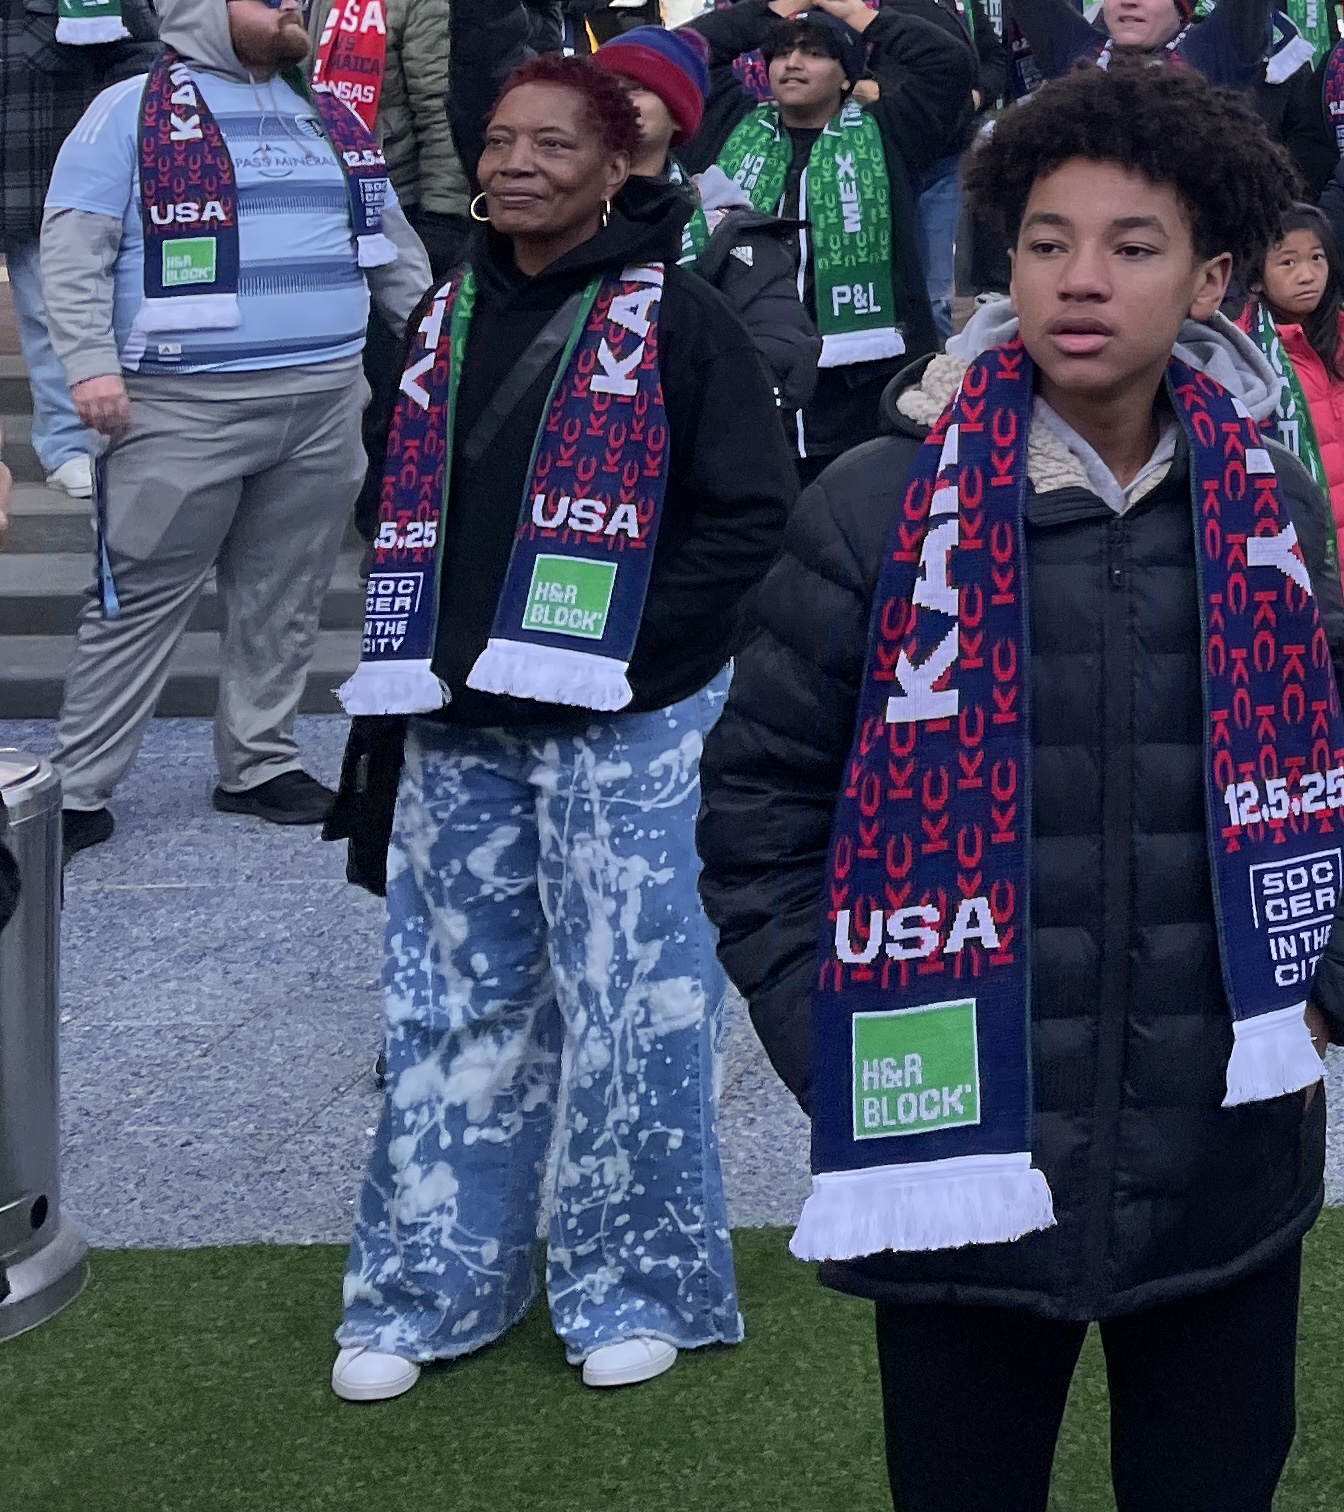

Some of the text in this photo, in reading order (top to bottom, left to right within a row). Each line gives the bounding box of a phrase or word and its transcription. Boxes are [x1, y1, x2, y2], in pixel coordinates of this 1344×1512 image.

[275, 155, 337, 169] MINERAL
[151, 200, 226, 225] USA
[835, 152, 861, 233] MEX
[165, 267, 212, 282] BLOCK
[166, 254, 192, 269] H&R
[832, 282, 881, 316] P&L
[587, 390, 611, 436] KC
[960, 364, 989, 433] KC
[558, 418, 580, 467] KC
[604, 424, 626, 472] KC
[645, 425, 666, 476] KC
[991, 407, 1017, 486] KC
[531, 493, 639, 538] USA
[894, 477, 934, 562] KC
[960, 466, 984, 550] KC
[991, 522, 1014, 604] KC
[536, 580, 578, 604] H&R
[374, 620, 407, 636] THE
[530, 605, 601, 633] BLOCK
[960, 584, 984, 670] KC
[1262, 861, 1335, 895] SOC
[1264, 892, 1337, 922] CER
[834, 896, 1001, 964] USA
[1269, 932, 1301, 961] IN
[1275, 960, 1322, 987] CIT
[862, 1052, 923, 1093] H&R
[862, 1086, 971, 1130] BLOCK
